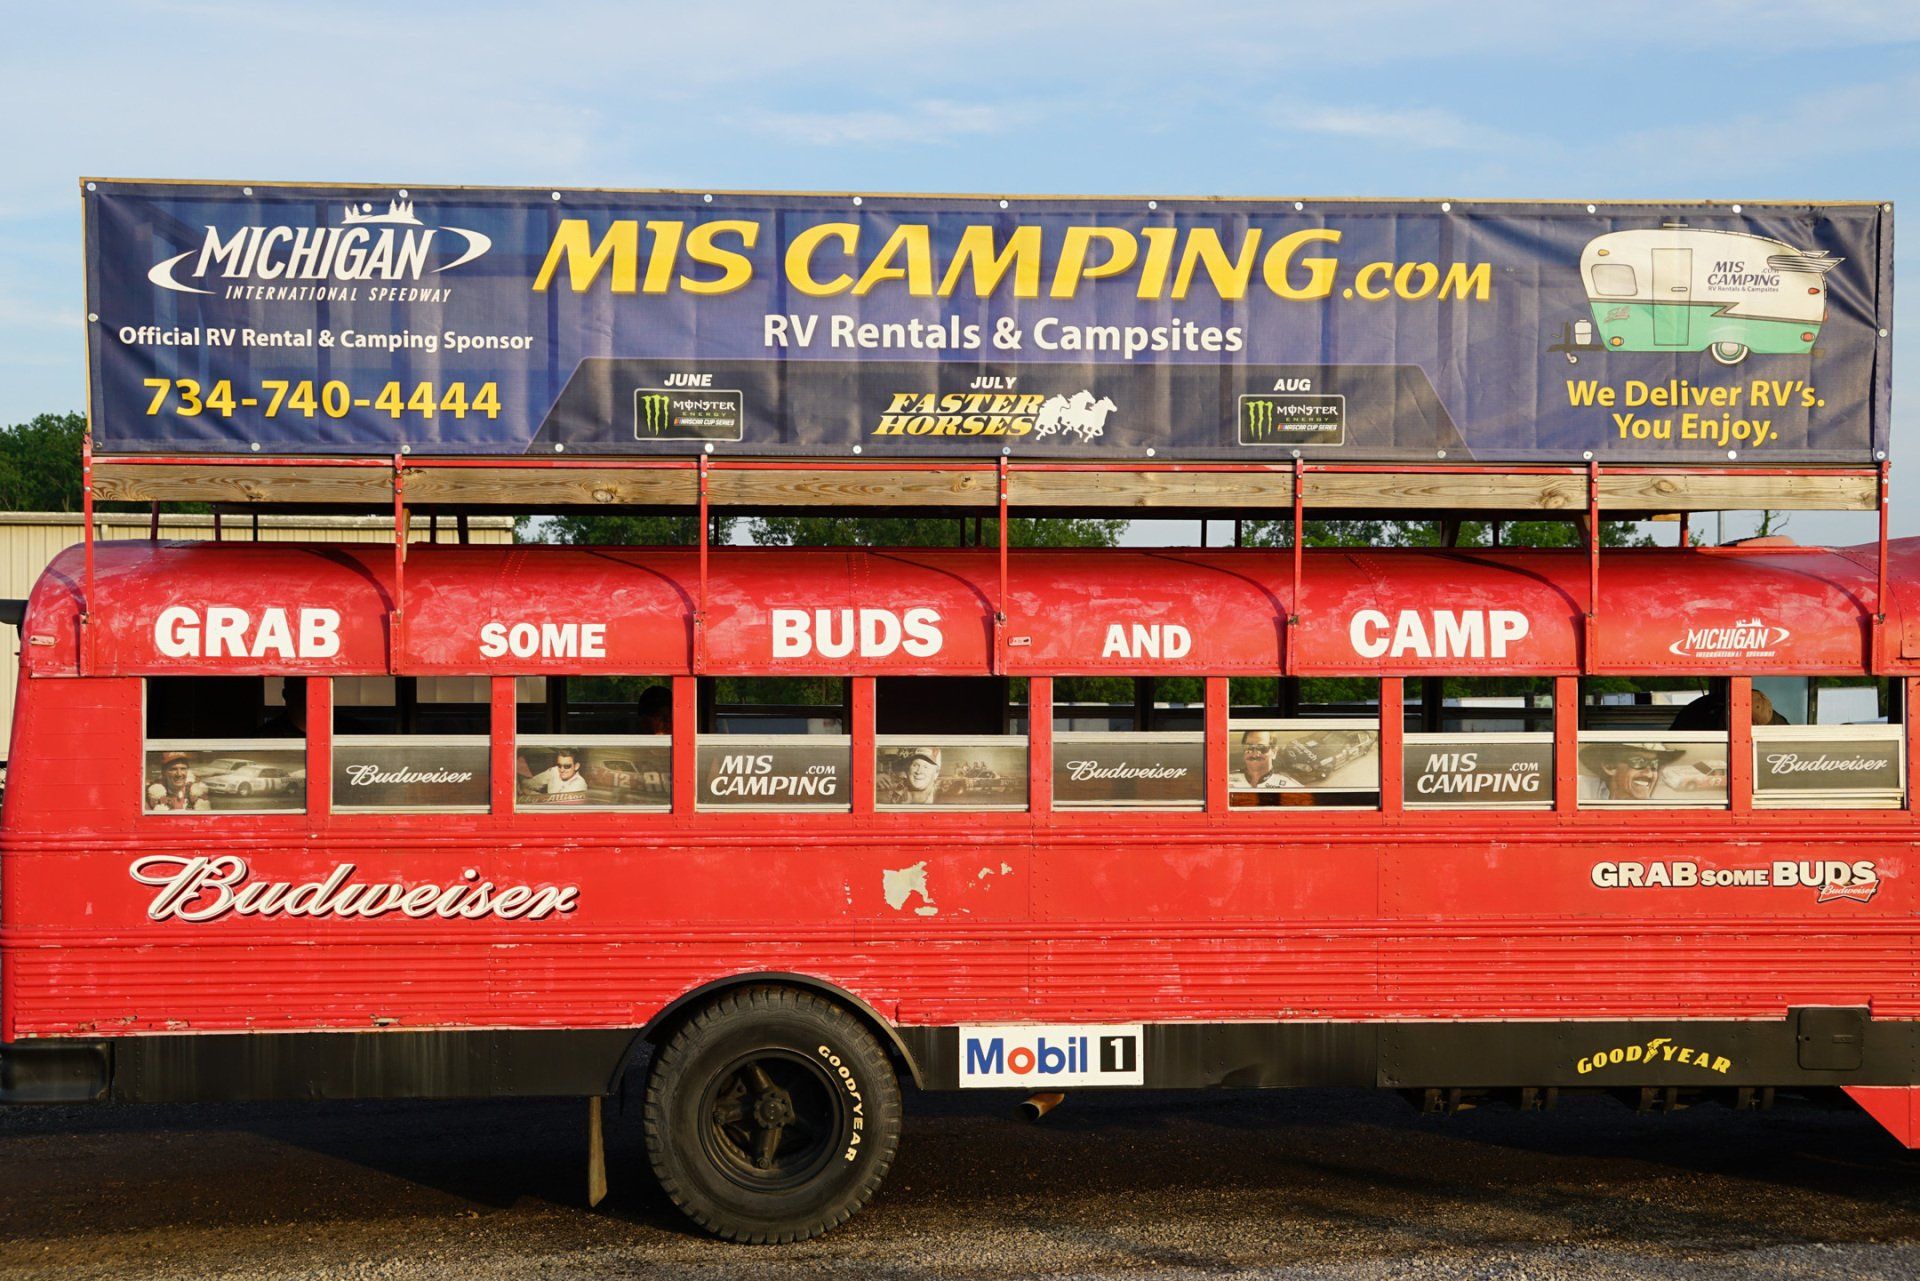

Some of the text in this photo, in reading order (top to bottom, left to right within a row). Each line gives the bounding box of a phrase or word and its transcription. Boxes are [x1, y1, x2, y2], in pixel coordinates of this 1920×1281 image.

[192, 225, 438, 281] MICHIGAN
[532, 219, 760, 295] MIS
[1713, 260, 1745, 273] MIS
[1707, 274, 1780, 286] CAMPING
[225, 285, 453, 303] INTERNATIONAL SPEEDWAY
[118, 326, 534, 353] Official RV Rental & Camping Sponsor
[764, 315, 1243, 359] RV Rentals & Campsites
[664, 373, 713, 387] JUNE
[970, 376, 1017, 389] JULY
[1273, 379, 1311, 391] AUG
[143, 378, 502, 420] 734-740-4444
[883, 393, 1045, 414] FASTER
[1566, 380, 1825, 408] We Deliver RV's.
[673, 400, 736, 411] MONSTER
[1277, 404, 1338, 416] MONSTER
[871, 415, 1036, 436] HORSES
[1612, 413, 1778, 447] You Enjoy.
[155, 606, 1530, 658] GRAB SOME BUDS AND CAMP
[1684, 628, 1770, 650] MICHIGAN
[718, 754, 773, 775] MIS
[805, 765, 836, 775] .COM
[1066, 760, 1188, 781] Budweiser
[1425, 753, 1478, 773] MIS
[1509, 762, 1539, 772] .COM
[1766, 753, 1888, 775] Budweiser
[346, 763, 472, 786] Budweiser
[613, 773, 631, 788] 12
[1416, 774, 1540, 794] CAMPING
[710, 776, 837, 796] CAMPING
[1591, 861, 1877, 888] GRAB SOME BUDS
[129, 855, 581, 922] Budweiser
[966, 1036, 1124, 1075] Mobil 1
[1577, 1037, 1732, 1074] GOODYEAR
[818, 1044, 864, 1163] GOODYEAR
